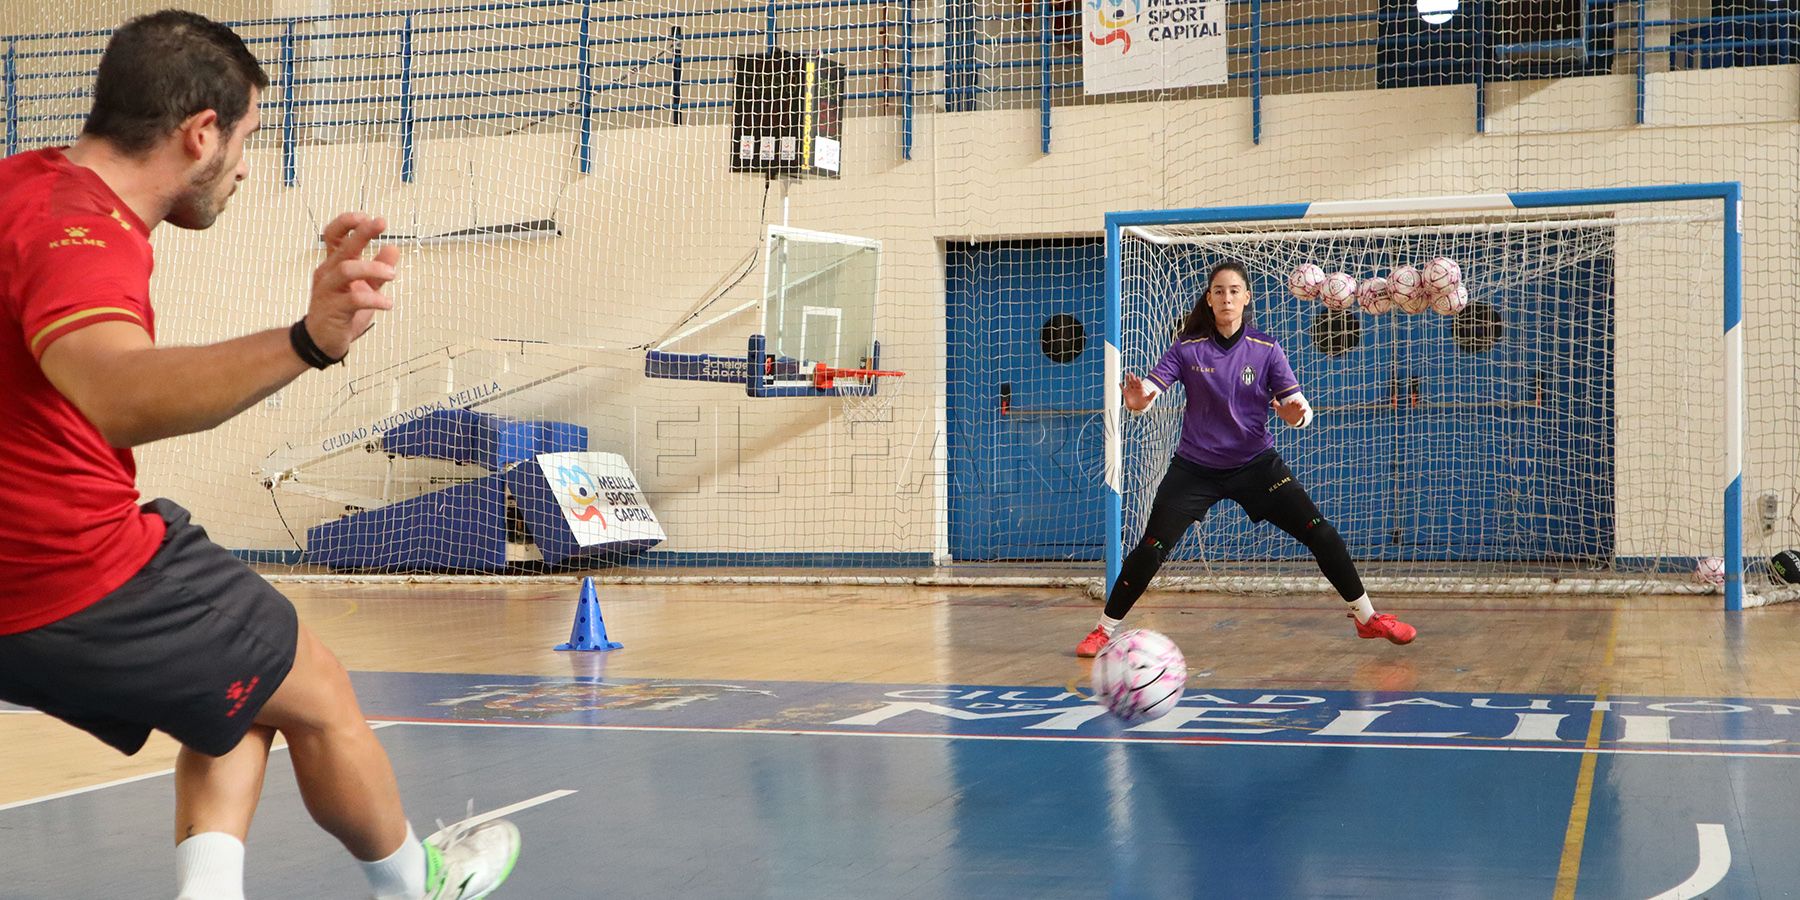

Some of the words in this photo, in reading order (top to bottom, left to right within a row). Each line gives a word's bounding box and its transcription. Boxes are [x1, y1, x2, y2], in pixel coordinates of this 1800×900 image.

[1148, 6, 1206, 25] SPORT
[1148, 22, 1222, 42] CAPITAL
[49, 238, 107, 248] KELME
[322, 427, 367, 452] CIUDAD
[371, 401, 446, 436] AUTONOMA
[448, 381, 502, 409] MELILLA
[597, 476, 638, 491] MELILLA
[1268, 476, 1292, 493] KELME
[604, 491, 639, 507] SPORT
[614, 508, 654, 523] CAPITAL
[884, 689, 1326, 706] CIUAD
[966, 702, 1049, 710] DE
